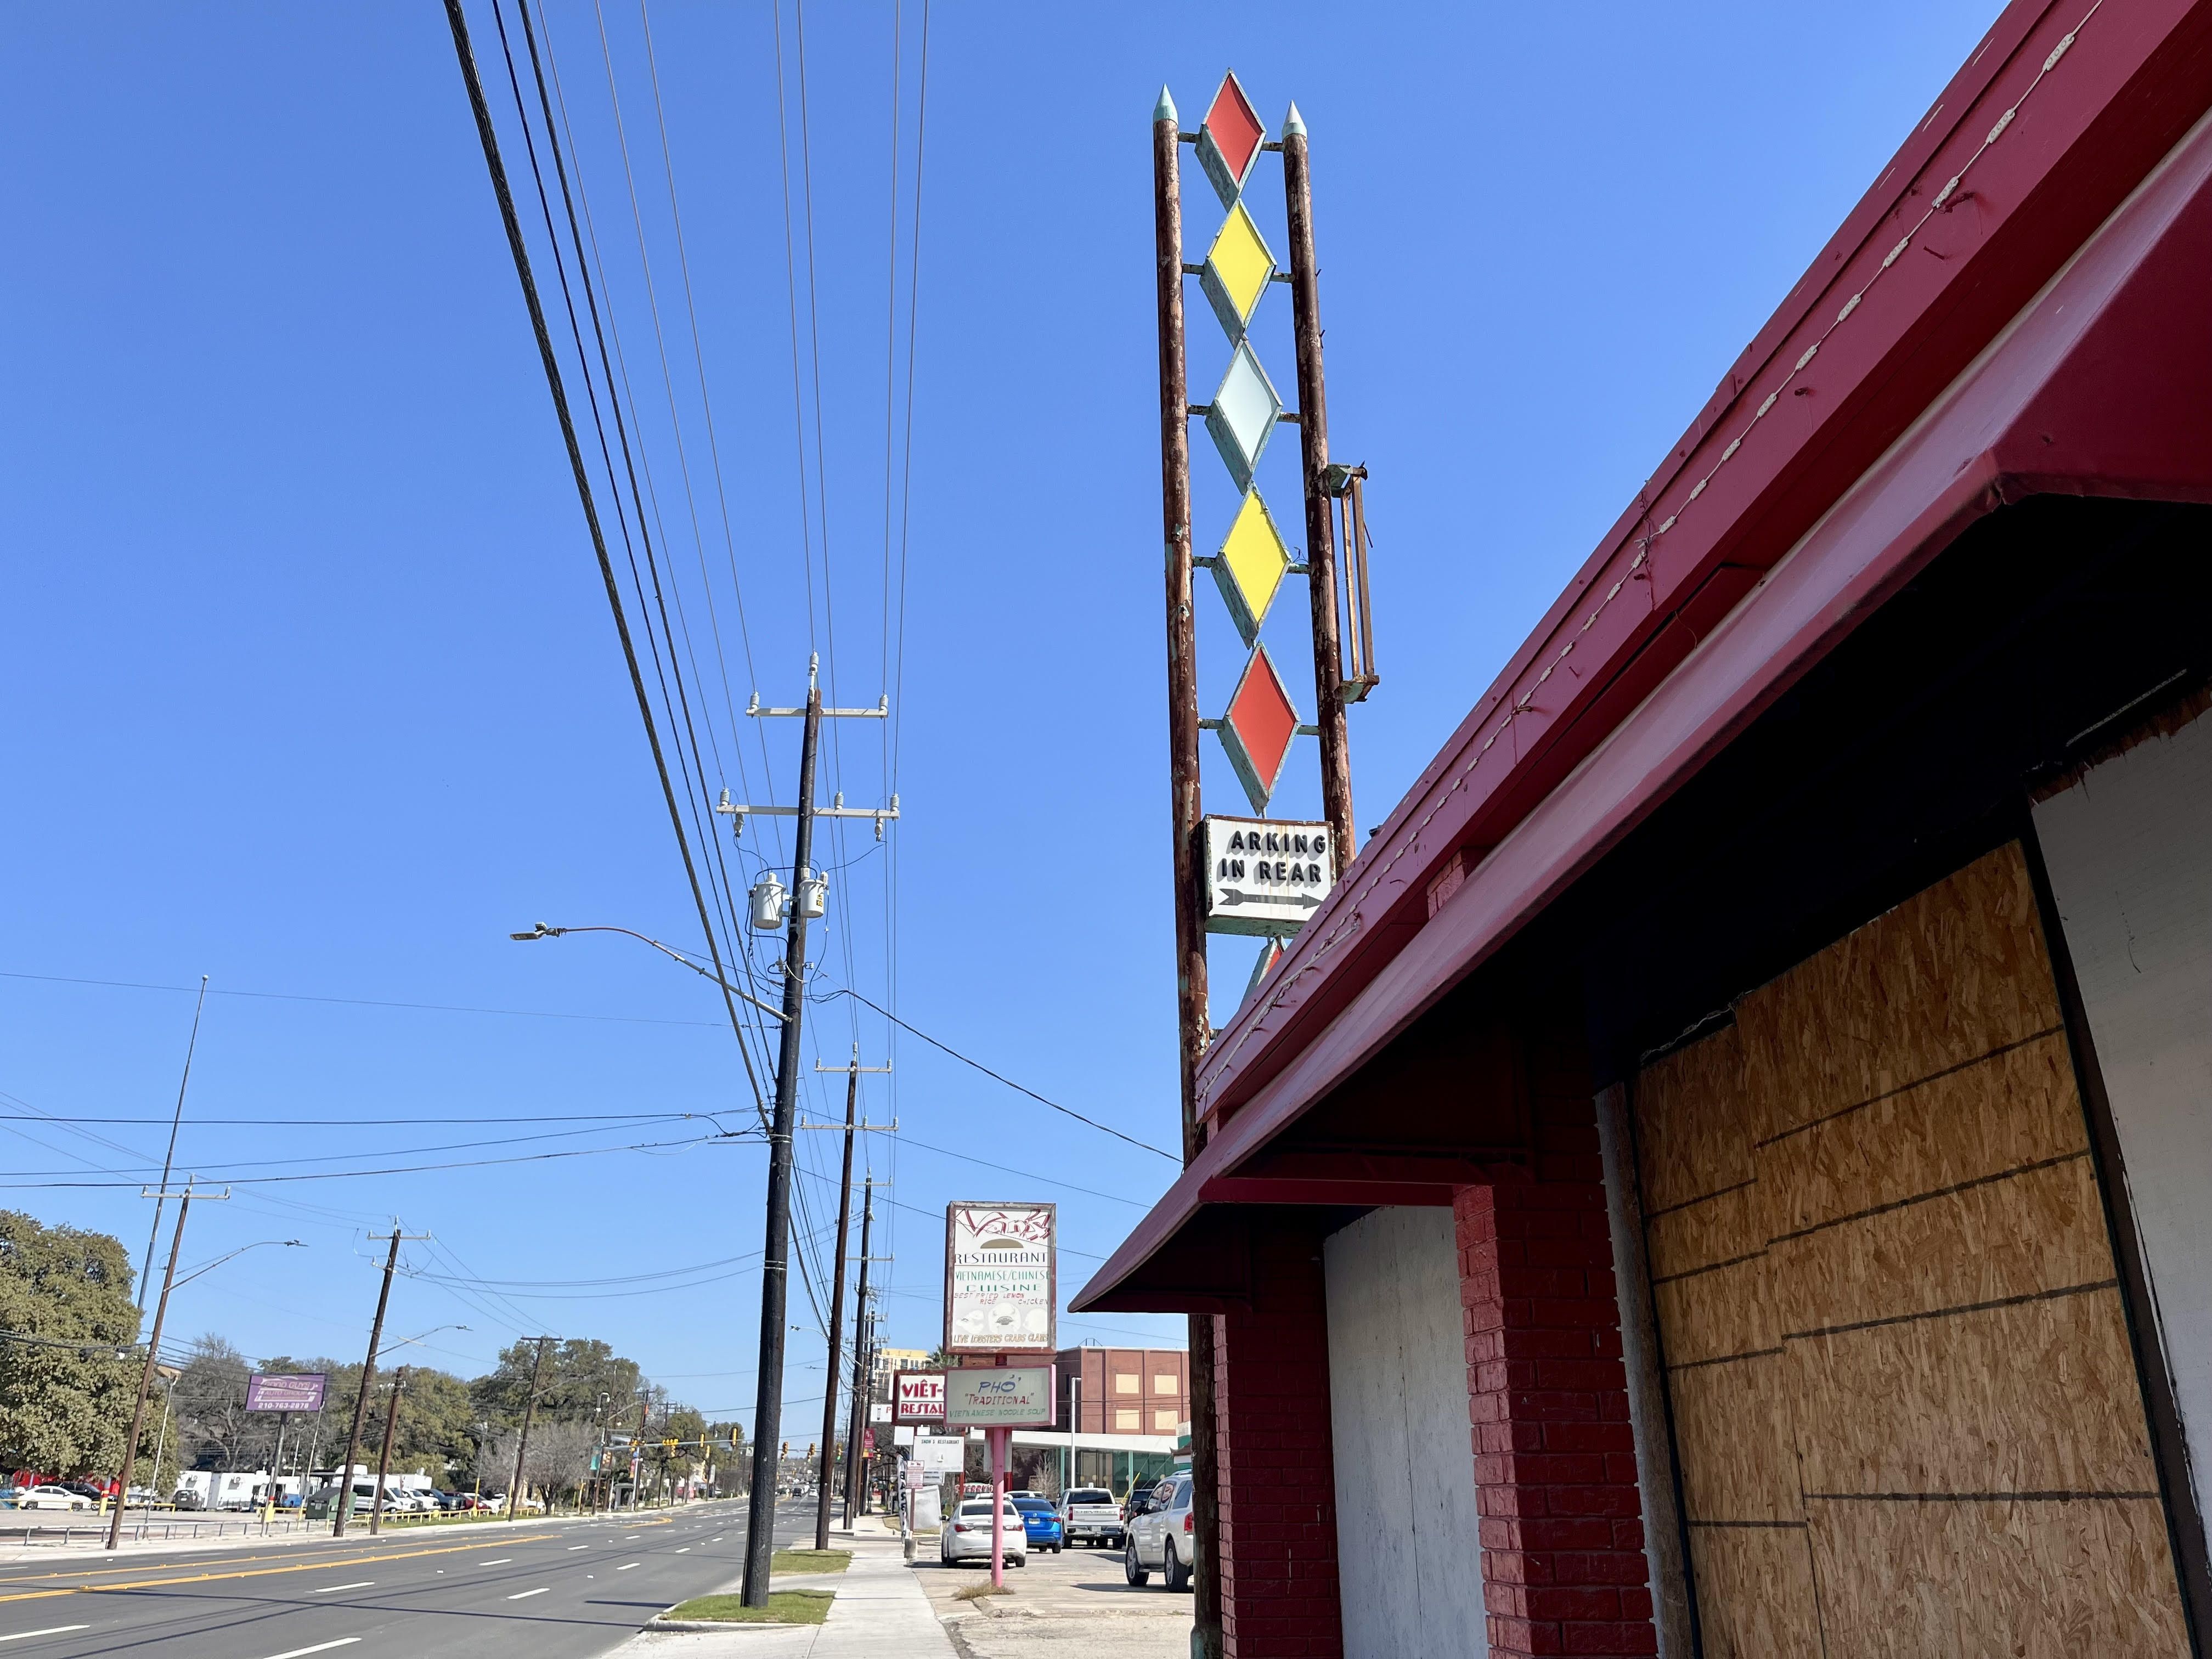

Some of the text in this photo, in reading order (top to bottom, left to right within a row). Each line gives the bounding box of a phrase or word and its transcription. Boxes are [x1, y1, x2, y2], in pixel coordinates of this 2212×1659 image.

[1230, 830, 1326, 854] ARKING
[1221, 857, 1322, 882] IN REAR
[955, 1252, 1049, 1264] RESTAURANT
[953, 1334, 969, 1343] LIVE
[970, 1334, 1003, 1343] LOBSTERS
[949, 1409, 995, 1418] VIETNAMESE
